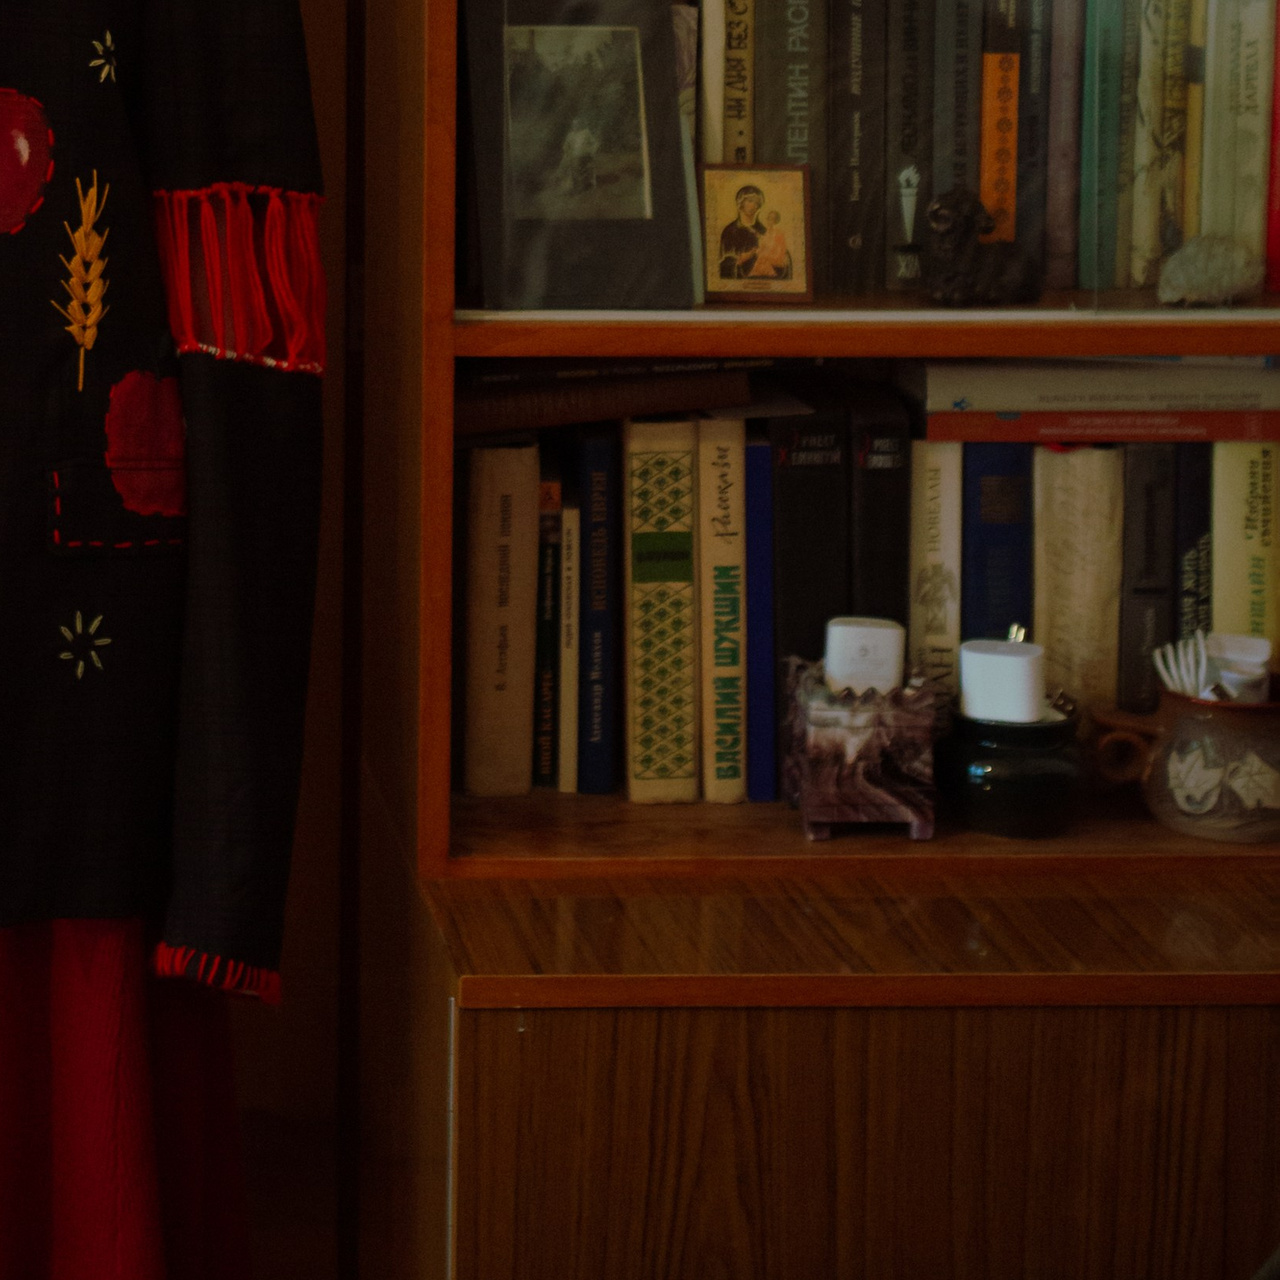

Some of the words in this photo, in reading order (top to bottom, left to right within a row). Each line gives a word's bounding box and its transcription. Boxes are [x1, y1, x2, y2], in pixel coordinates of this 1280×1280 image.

[725, 20, 748, 51] БЕЗ
[725, 58, 746, 93] ДНЯ
[726, 98, 746, 121] НИ
[927, 467, 942, 553] НОВЕЛЛЫ
[590, 527, 607, 611] ИСПОВЕДЬ
[712, 565, 740, 667] ШУКШИН
[713, 676, 741, 781] ВАСИЛИЙ
